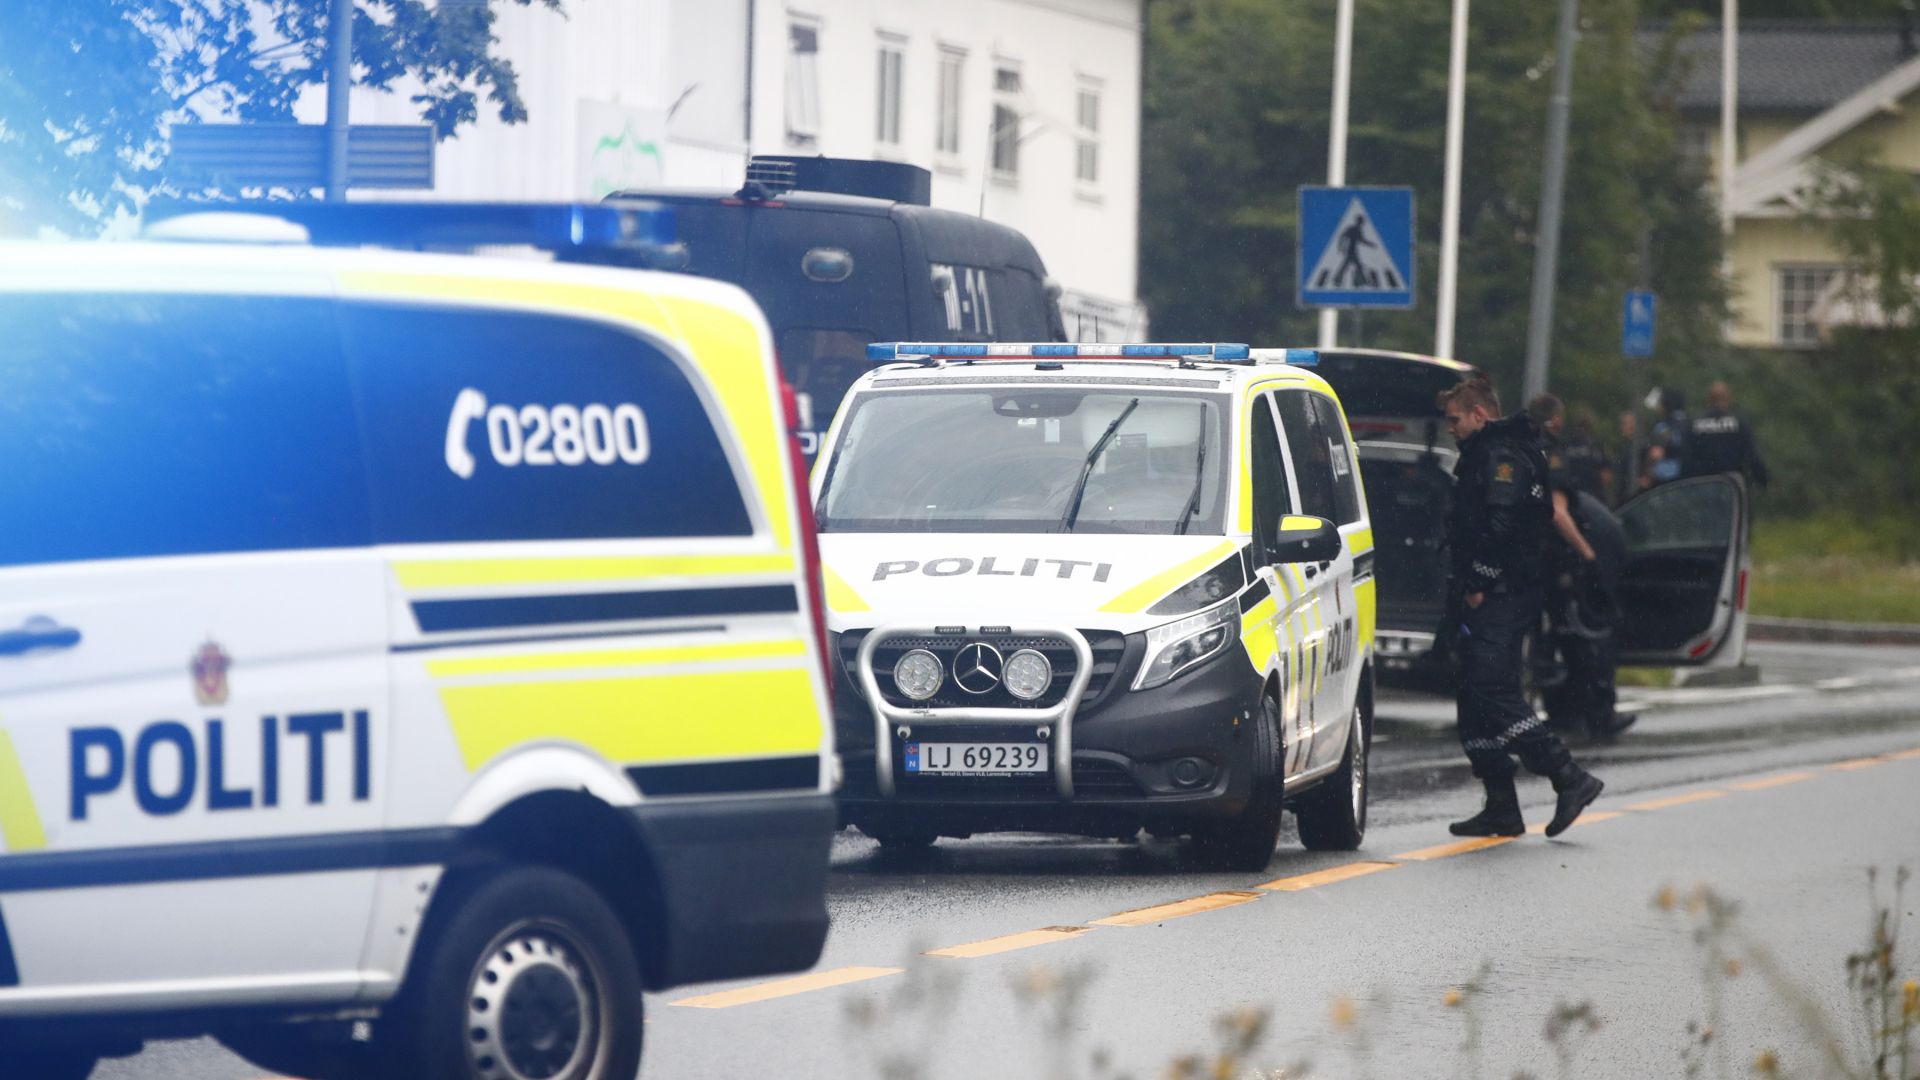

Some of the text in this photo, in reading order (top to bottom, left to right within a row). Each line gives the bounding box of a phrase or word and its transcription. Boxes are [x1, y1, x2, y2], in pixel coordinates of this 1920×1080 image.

[487, 403, 650, 466] 02800
[872, 557, 1112, 583] POLITI
[1324, 617, 1352, 677] POLITI
[69, 709, 370, 820] POLITI
[908, 760, 916, 768] N
[927, 746, 1039, 769] LJ 69239
